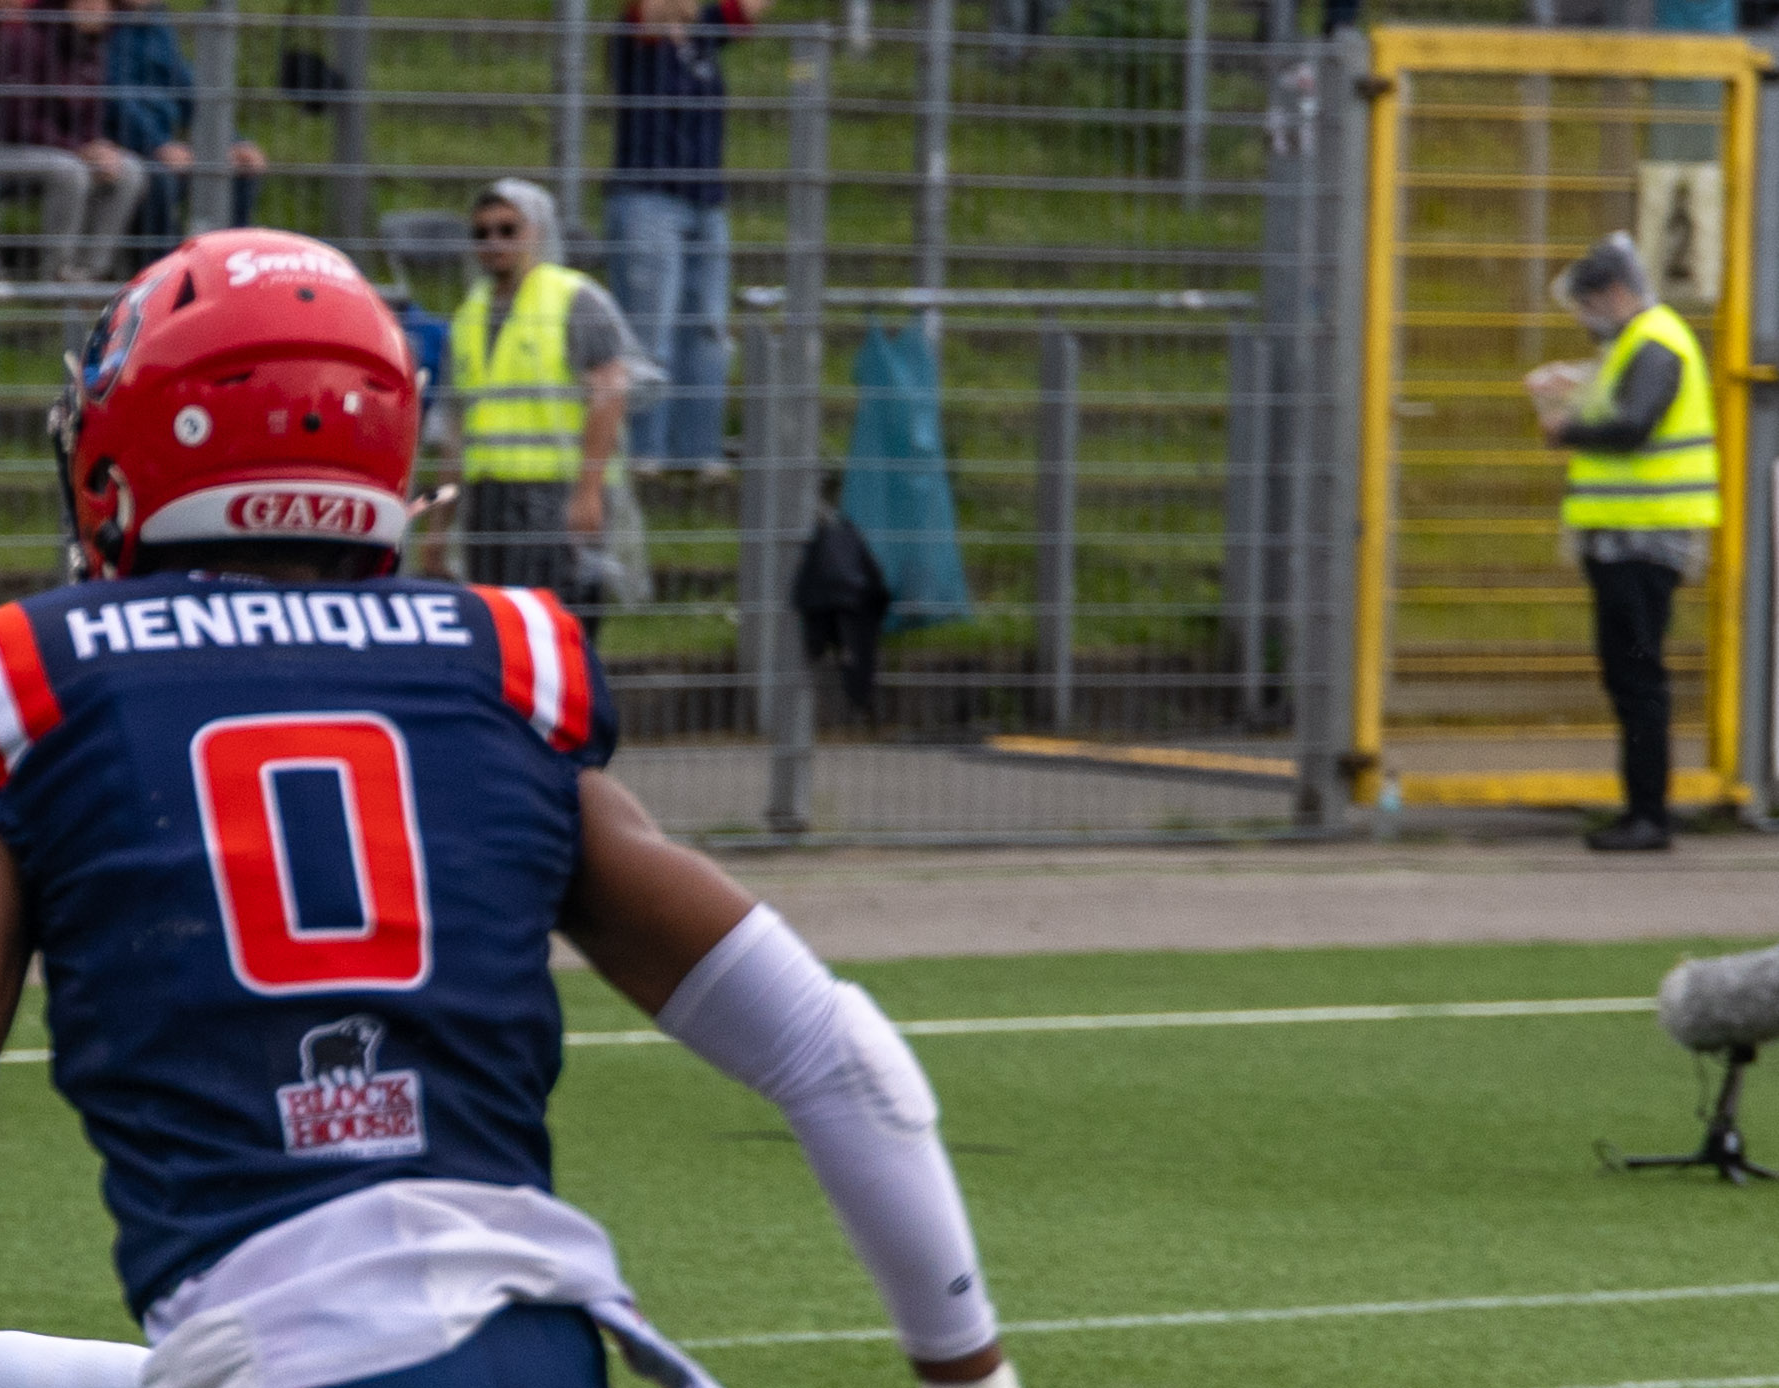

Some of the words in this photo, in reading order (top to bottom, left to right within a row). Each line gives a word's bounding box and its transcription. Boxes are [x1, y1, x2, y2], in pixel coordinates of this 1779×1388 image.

[242, 494, 374, 533] GAZI
[66, 592, 472, 659] HENRIQUE
[189, 710, 434, 997] 0
